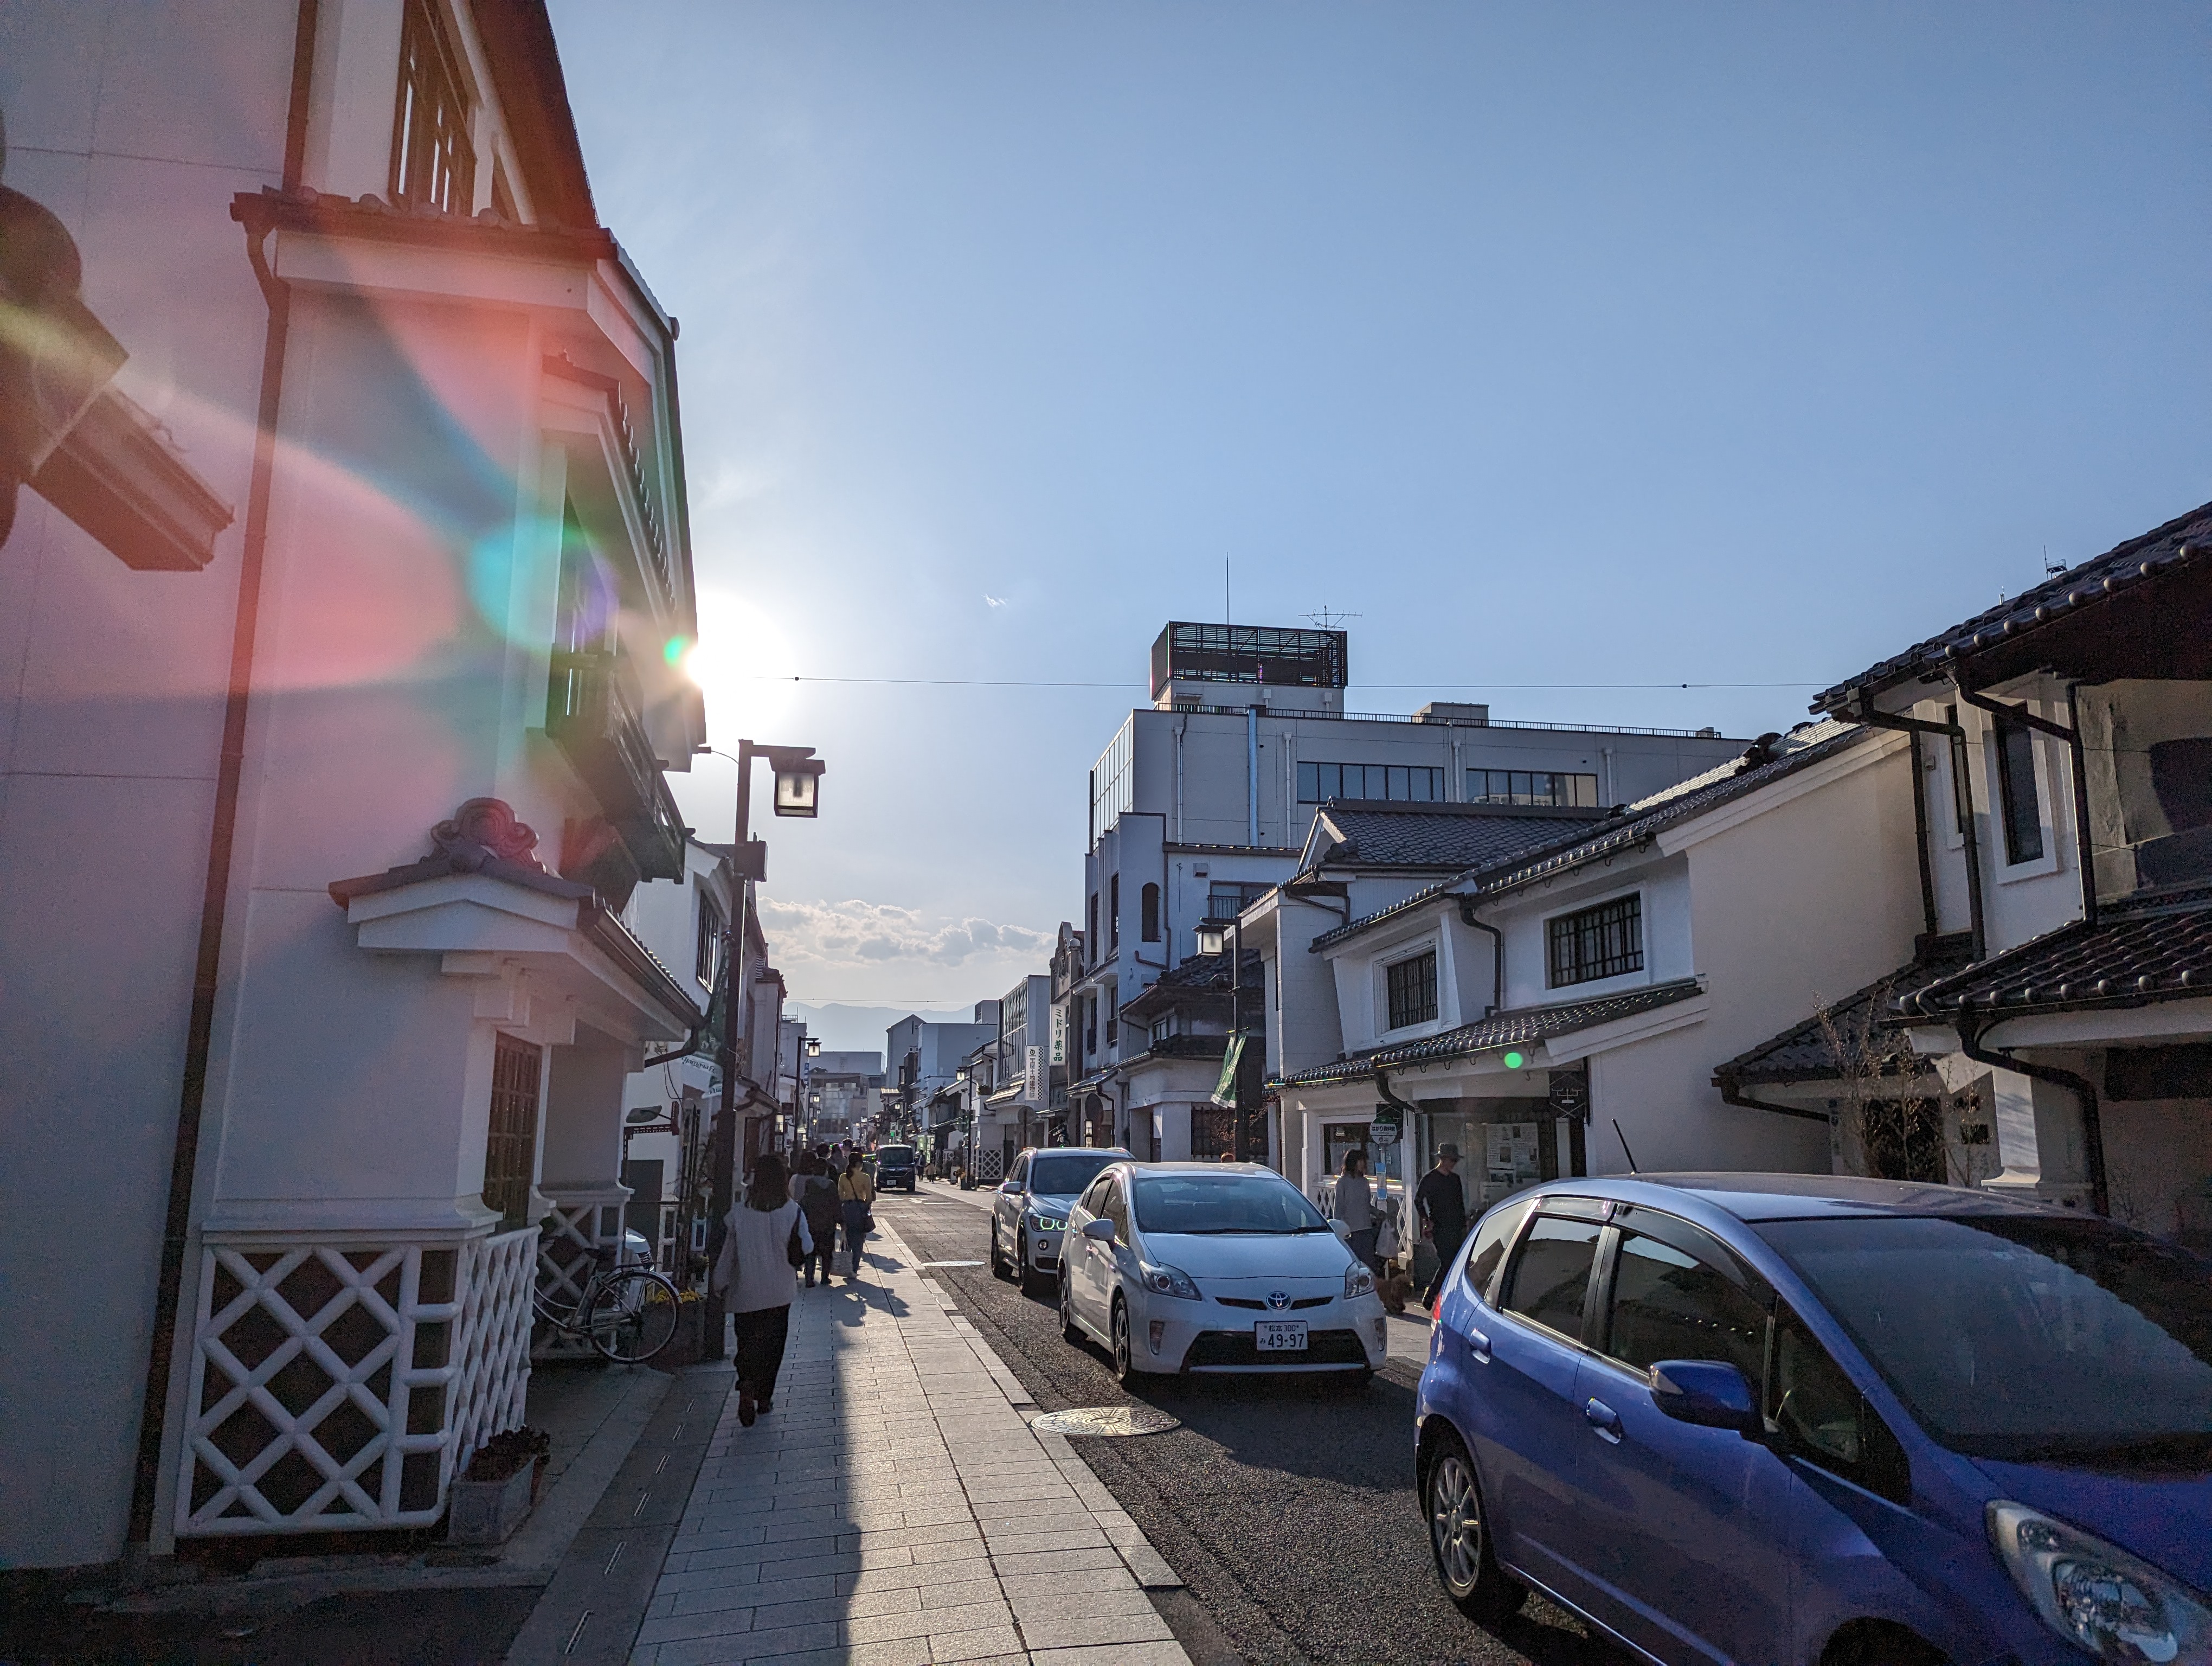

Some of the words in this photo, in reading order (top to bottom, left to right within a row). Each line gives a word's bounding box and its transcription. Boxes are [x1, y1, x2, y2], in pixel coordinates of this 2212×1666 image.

[1053, 1009, 1063, 1062] ミドリ薬品
[1268, 1334, 1304, 1348] 49-97
